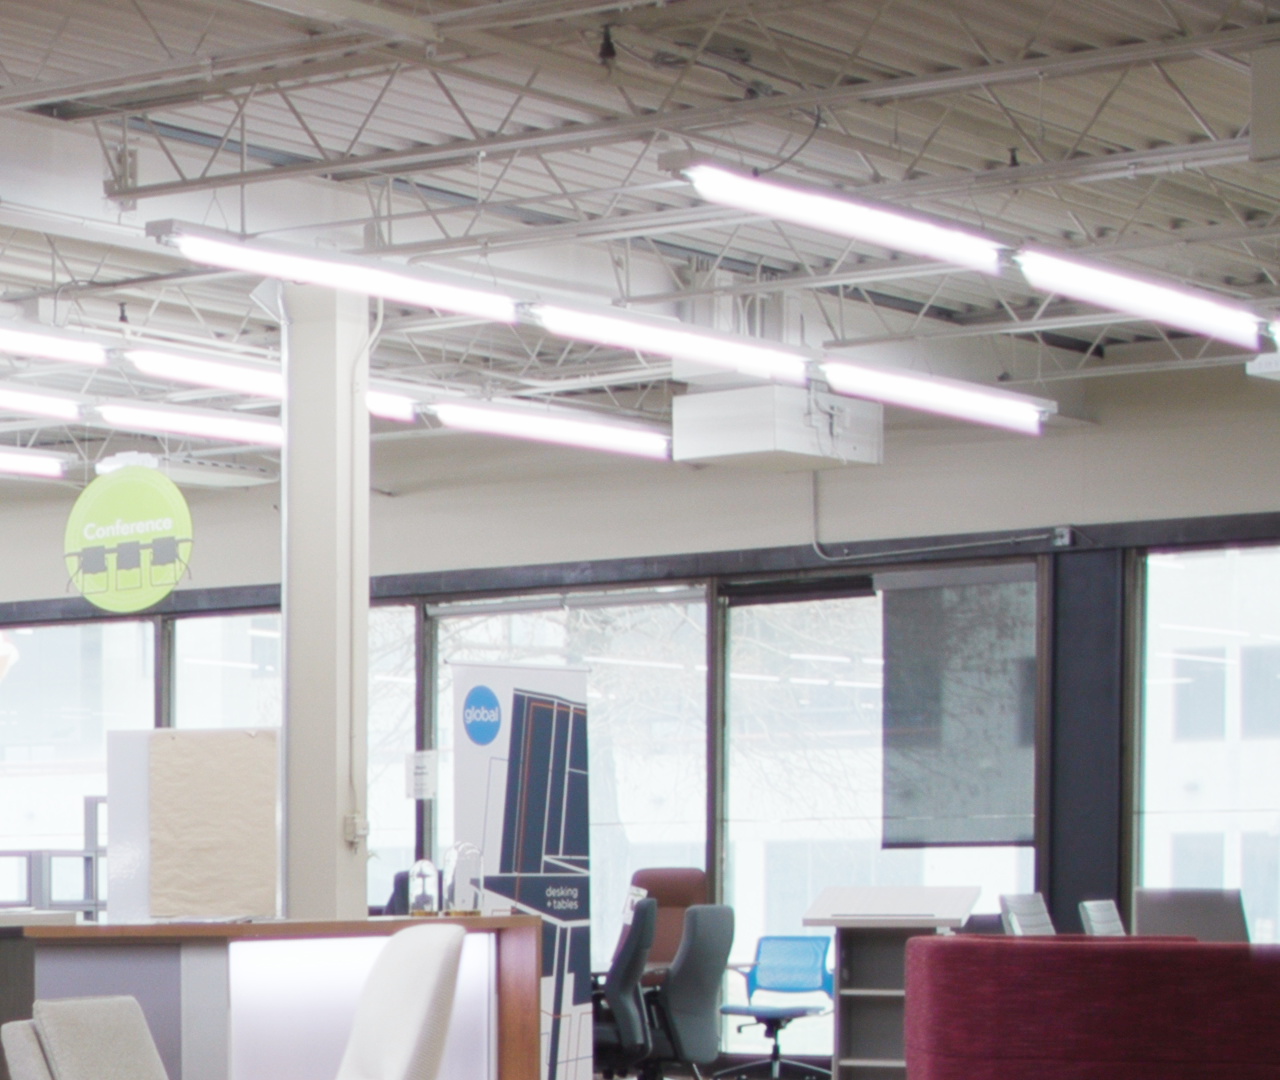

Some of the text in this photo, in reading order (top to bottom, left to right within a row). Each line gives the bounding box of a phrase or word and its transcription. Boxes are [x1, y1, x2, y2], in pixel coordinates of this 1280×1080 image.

[82, 517, 173, 540] Conference
[464, 705, 499, 724] global
[545, 885, 578, 899] desking
[553, 899, 578, 910] tables
